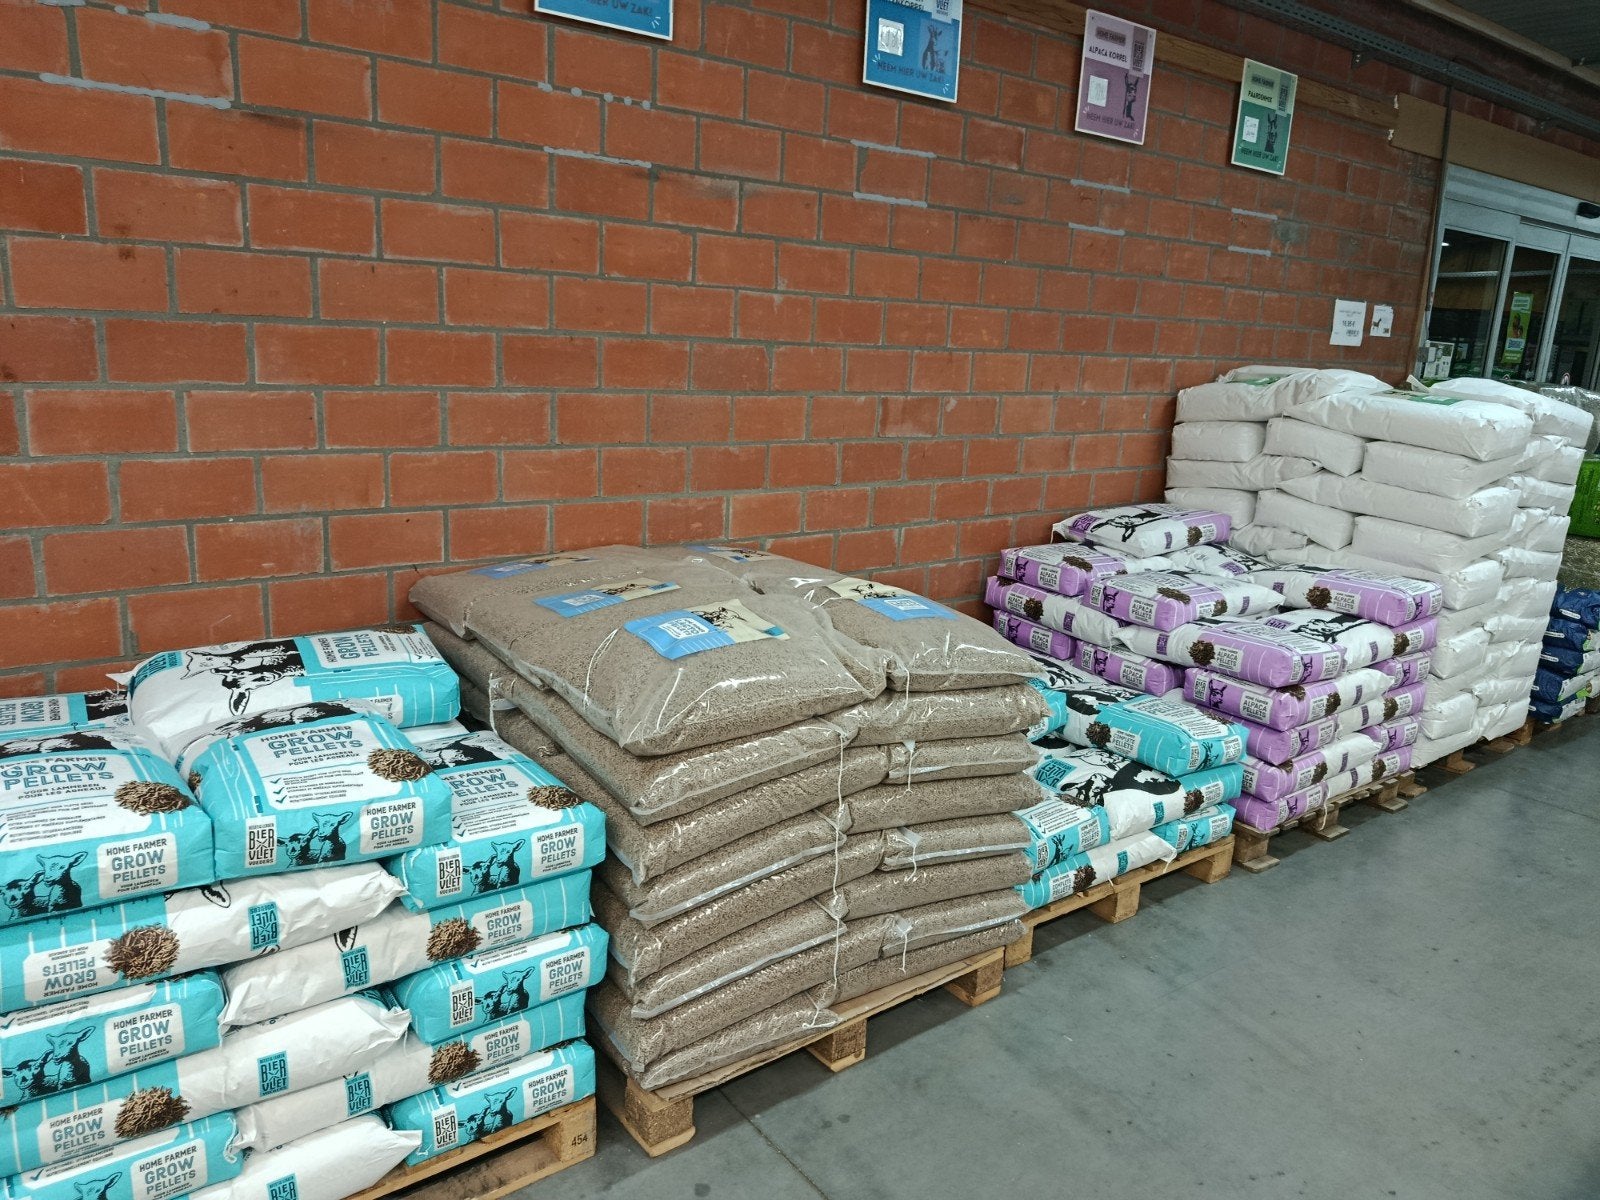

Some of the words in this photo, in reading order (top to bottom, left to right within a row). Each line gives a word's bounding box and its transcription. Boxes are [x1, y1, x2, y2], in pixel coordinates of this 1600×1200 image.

[1088, 45, 1108, 57] ALPACA
[1039, 576, 1057, 586] PELLETS
[1040, 571, 1058, 580] ALPACA
[1333, 601, 1354, 610] PELLETS
[1334, 595, 1355, 605] ALPACA
[1132, 604, 1153, 614] ALPACA
[1132, 609, 1152, 620] PELLETS
[318, 638, 332, 652] FARMER
[332, 637, 360, 660] GROW
[355, 633, 380, 658] PELLETS
[324, 652, 337, 663] HOME
[1217, 651, 1238, 661] ALPACA
[1217, 657, 1237, 667] PELLETS
[1123, 669, 1142, 679] ALPACA
[21, 701, 45, 722] GROW
[1243, 706, 1266, 718] PELLETS
[1244, 700, 1267, 712] ALPACA
[261, 732, 298, 742] HOME
[302, 725, 352, 737] FARMER
[268, 731, 353, 750] GROW
[1113, 734, 1136, 744] COMPLETE
[273, 740, 363, 759] PELLETS
[1112, 740, 1134, 750] PELLETS
[326, 753, 361, 761] AGNEAUX
[1, 762, 106, 778] GROW
[459, 769, 502, 778] FARMER
[4, 772, 114, 790] PELLETS
[52, 783, 99, 791] LAMMEREN
[449, 773, 507, 790] ROW
[453, 781, 519, 798] ELLETS
[367, 807, 387, 816] HOME
[388, 802, 416, 812] FARMER
[370, 811, 414, 830] GROW
[249, 828, 275, 850] BIER
[371, 825, 414, 840] PELLETS
[537, 833, 554, 843] HOME
[554, 827, 578, 838] FARMER
[106, 845, 130, 856] HOME
[133, 838, 167, 851] FARMER
[540, 836, 576, 854] GROW
[111, 849, 164, 871] GROW
[249, 848, 274, 860] VLIET
[541, 849, 576, 864] PELLETS
[113, 864, 166, 883] PELLETS
[439, 859, 461, 879] BIER
[439, 876, 461, 889] VLIET
[251, 911, 277, 926] VLIET
[485, 910, 499, 918] HOME
[500, 905, 521, 915] FARMER
[487, 912, 521, 931] GROW
[253, 922, 277, 945] BIER
[487, 924, 522, 940] PELLETS
[42, 957, 95, 977] PELLETS
[343, 953, 367, 976] BIER
[546, 959, 562, 969] HOME
[563, 951, 585, 963] FARMER
[346, 971, 368, 983] VLIET
[548, 960, 583, 980] GROW
[44, 968, 97, 991] GROW
[79, 982, 98, 991] HOME
[549, 971, 583, 989] PELLETS
[43, 986, 75, 997] FARMER
[452, 991, 473, 1012] BIER
[113, 1017, 137, 1030] HOME
[140, 1009, 173, 1022] FARMER
[452, 1009, 473, 1021] VLIET
[118, 1019, 170, 1045] GROW
[484, 1033, 499, 1041] HOME
[499, 1025, 519, 1037] FARMER
[120, 1035, 172, 1057] PELLETS
[486, 1033, 520, 1052] GROW
[487, 1043, 520, 1060] PELLETS
[260, 1059, 287, 1083] BIER
[528, 1078, 544, 1089] HOME
[545, 1069, 568, 1083] FARMER
[262, 1078, 287, 1091] VLIET
[347, 1080, 371, 1102] BIER
[532, 1078, 566, 1099] GROW
[349, 1097, 371, 1112] VLIET
[533, 1089, 567, 1108] PELLETS
[50, 1117, 71, 1129] HOME
[73, 1108, 103, 1122] FARMER
[435, 1115, 457, 1136] BIER
[52, 1117, 103, 1142] GROW
[436, 1131, 457, 1145] VLIET
[54, 1130, 105, 1152] PELLETS
[571, 1133, 588, 1147] 454
[139, 1158, 162, 1172] HOME
[165, 1146, 197, 1163] FARMER
[145, 1156, 194, 1184] GROW
[147, 1170, 196, 1195] PELLETS
[270, 1181, 296, 1200] BIER
